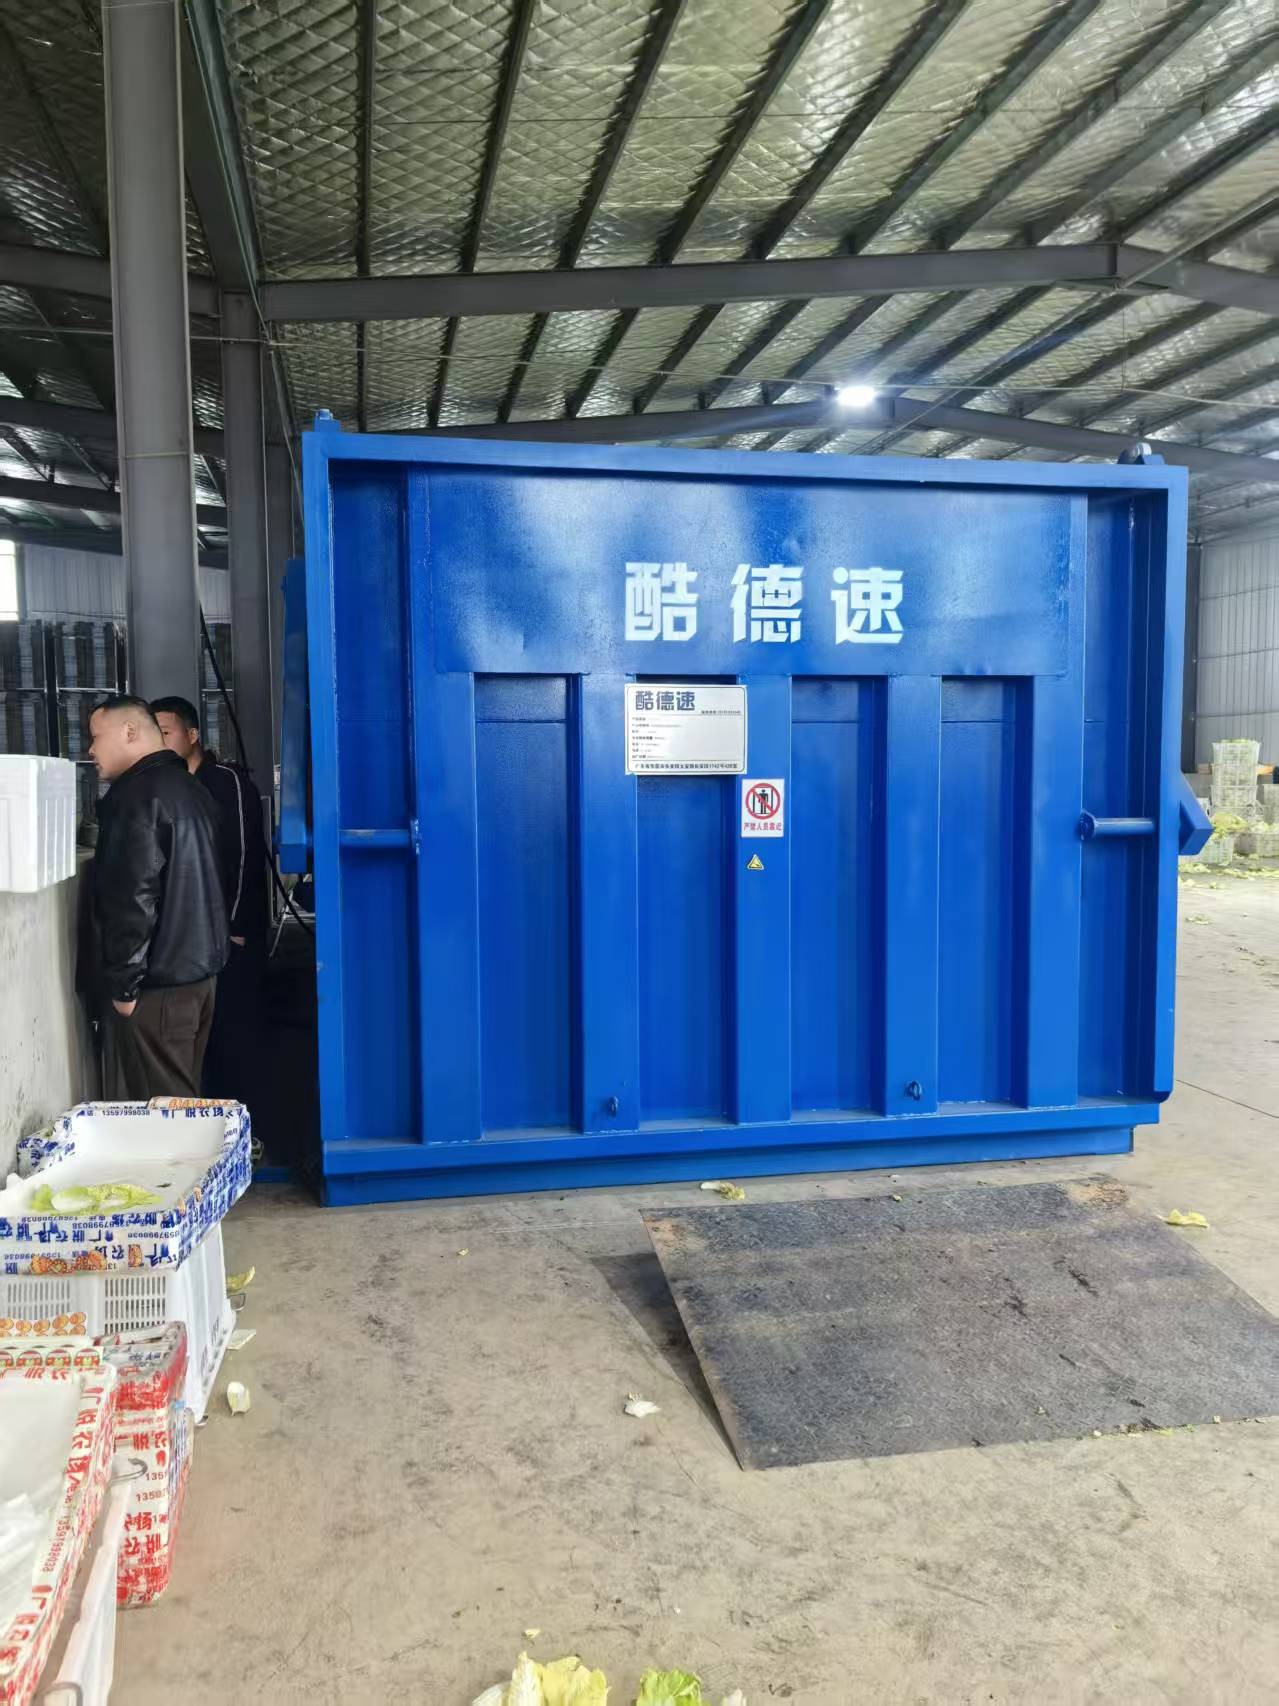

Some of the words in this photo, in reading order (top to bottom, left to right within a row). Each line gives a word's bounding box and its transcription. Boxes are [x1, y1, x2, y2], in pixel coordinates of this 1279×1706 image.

[625, 562, 904, 645] 酷德速
[635, 691, 695, 711] 酷德速
